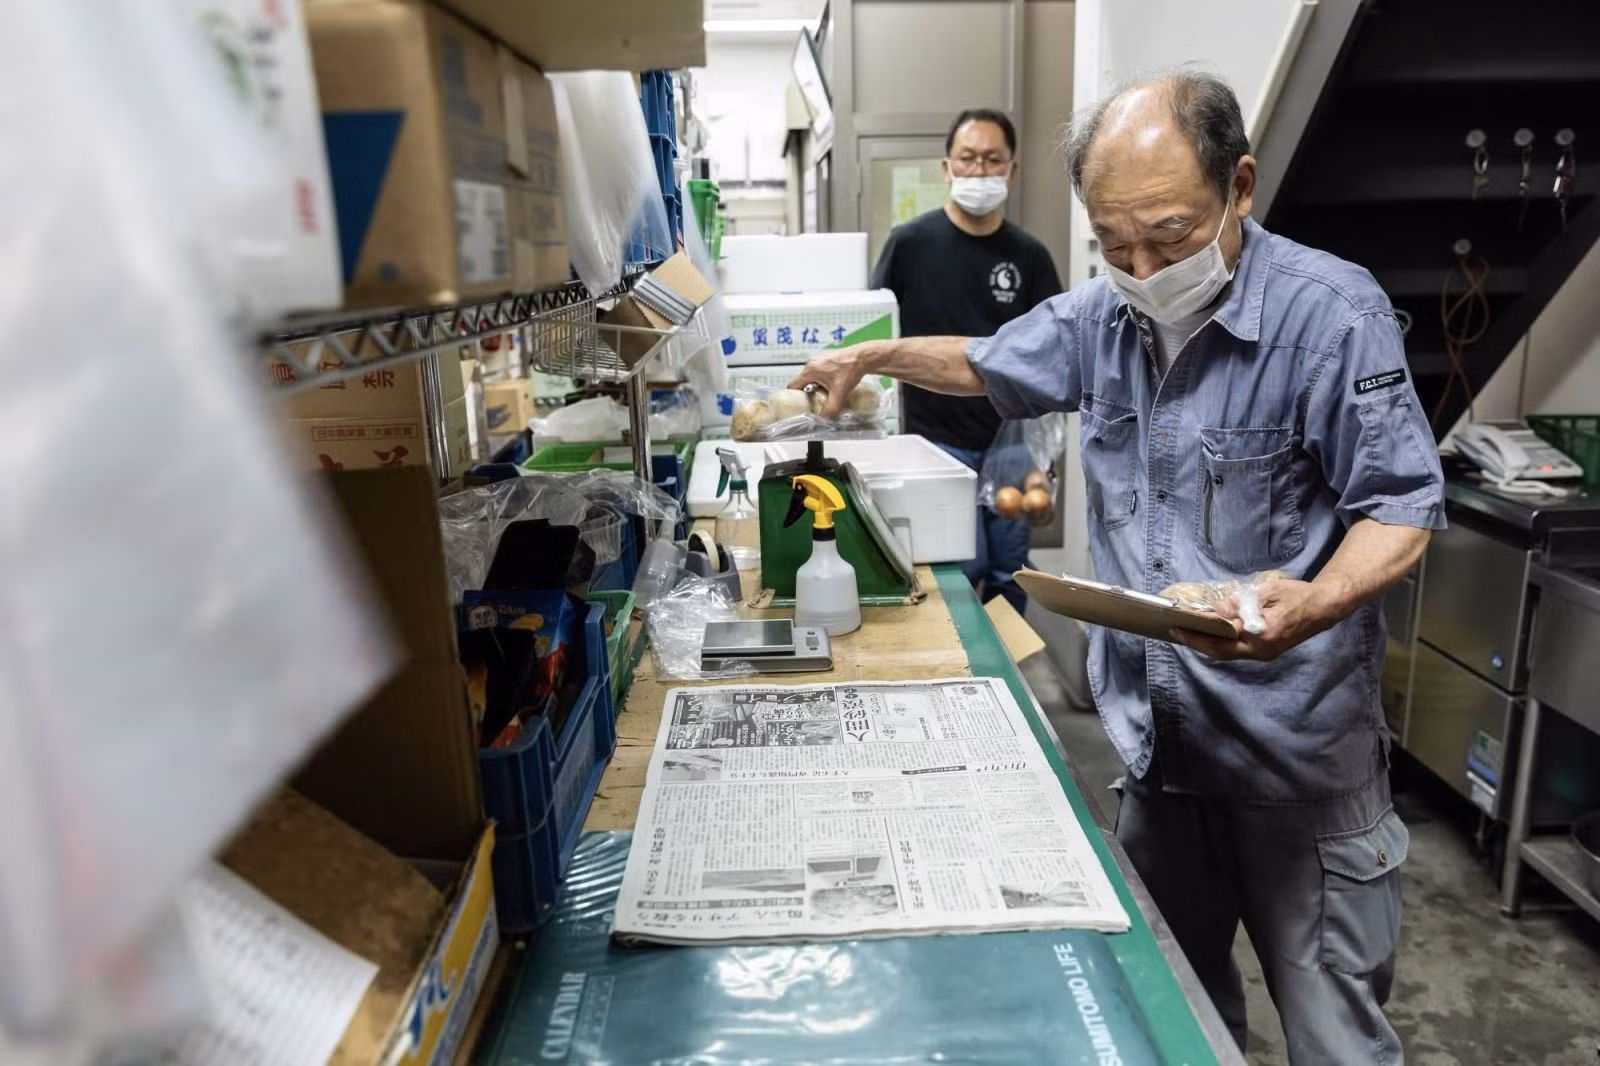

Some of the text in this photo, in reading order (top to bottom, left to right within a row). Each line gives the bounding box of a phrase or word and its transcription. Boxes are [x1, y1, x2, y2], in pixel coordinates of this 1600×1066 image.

[752, 325, 846, 346] 賀茂なす
[841, 699, 869, 742] 人間砂漠
[1053, 942, 1083, 972] LIFE
[540, 972, 585, 1059] CALENDAR
